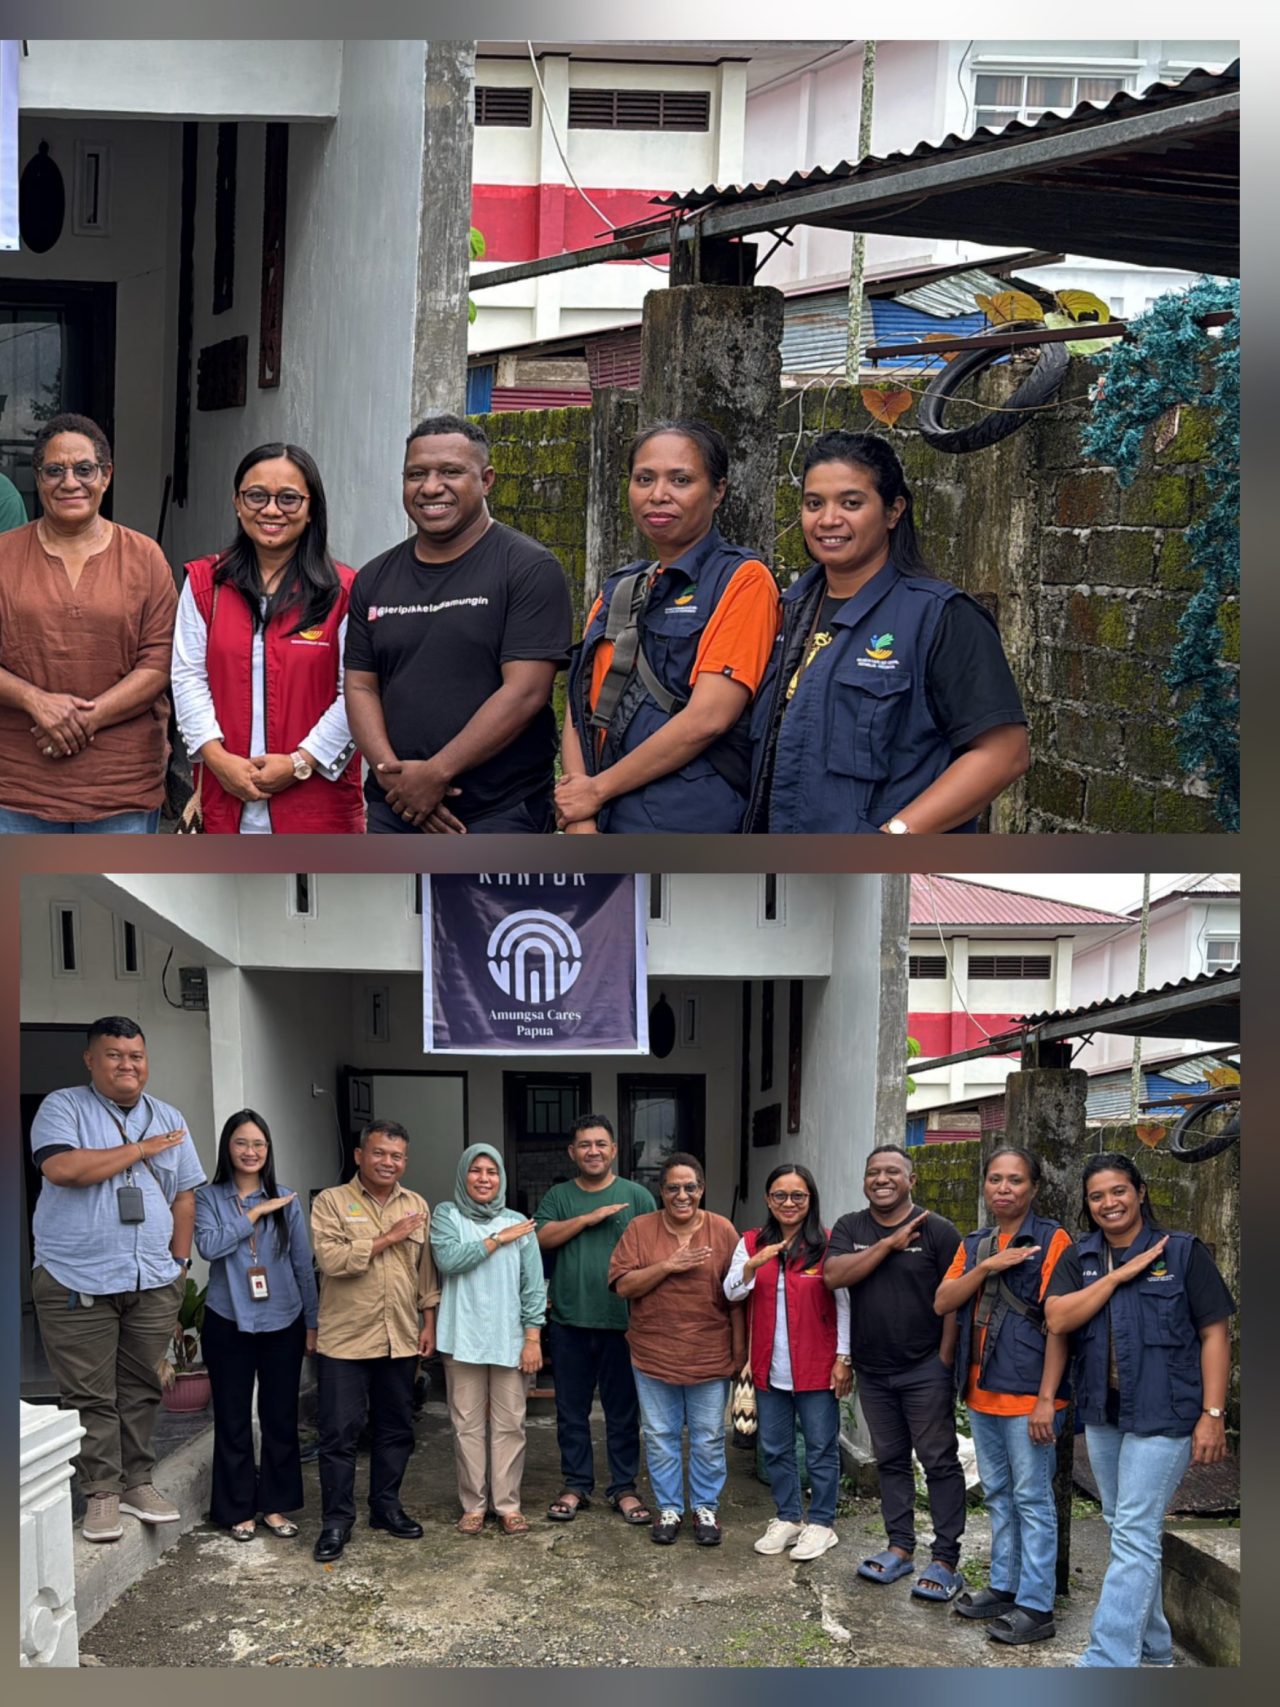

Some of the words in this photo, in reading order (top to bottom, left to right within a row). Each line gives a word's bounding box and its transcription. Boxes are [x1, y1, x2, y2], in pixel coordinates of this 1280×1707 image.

[489, 1009, 544, 1023] Amungsa
[547, 1010, 581, 1021] Cares
[517, 1025, 553, 1038] Papua
